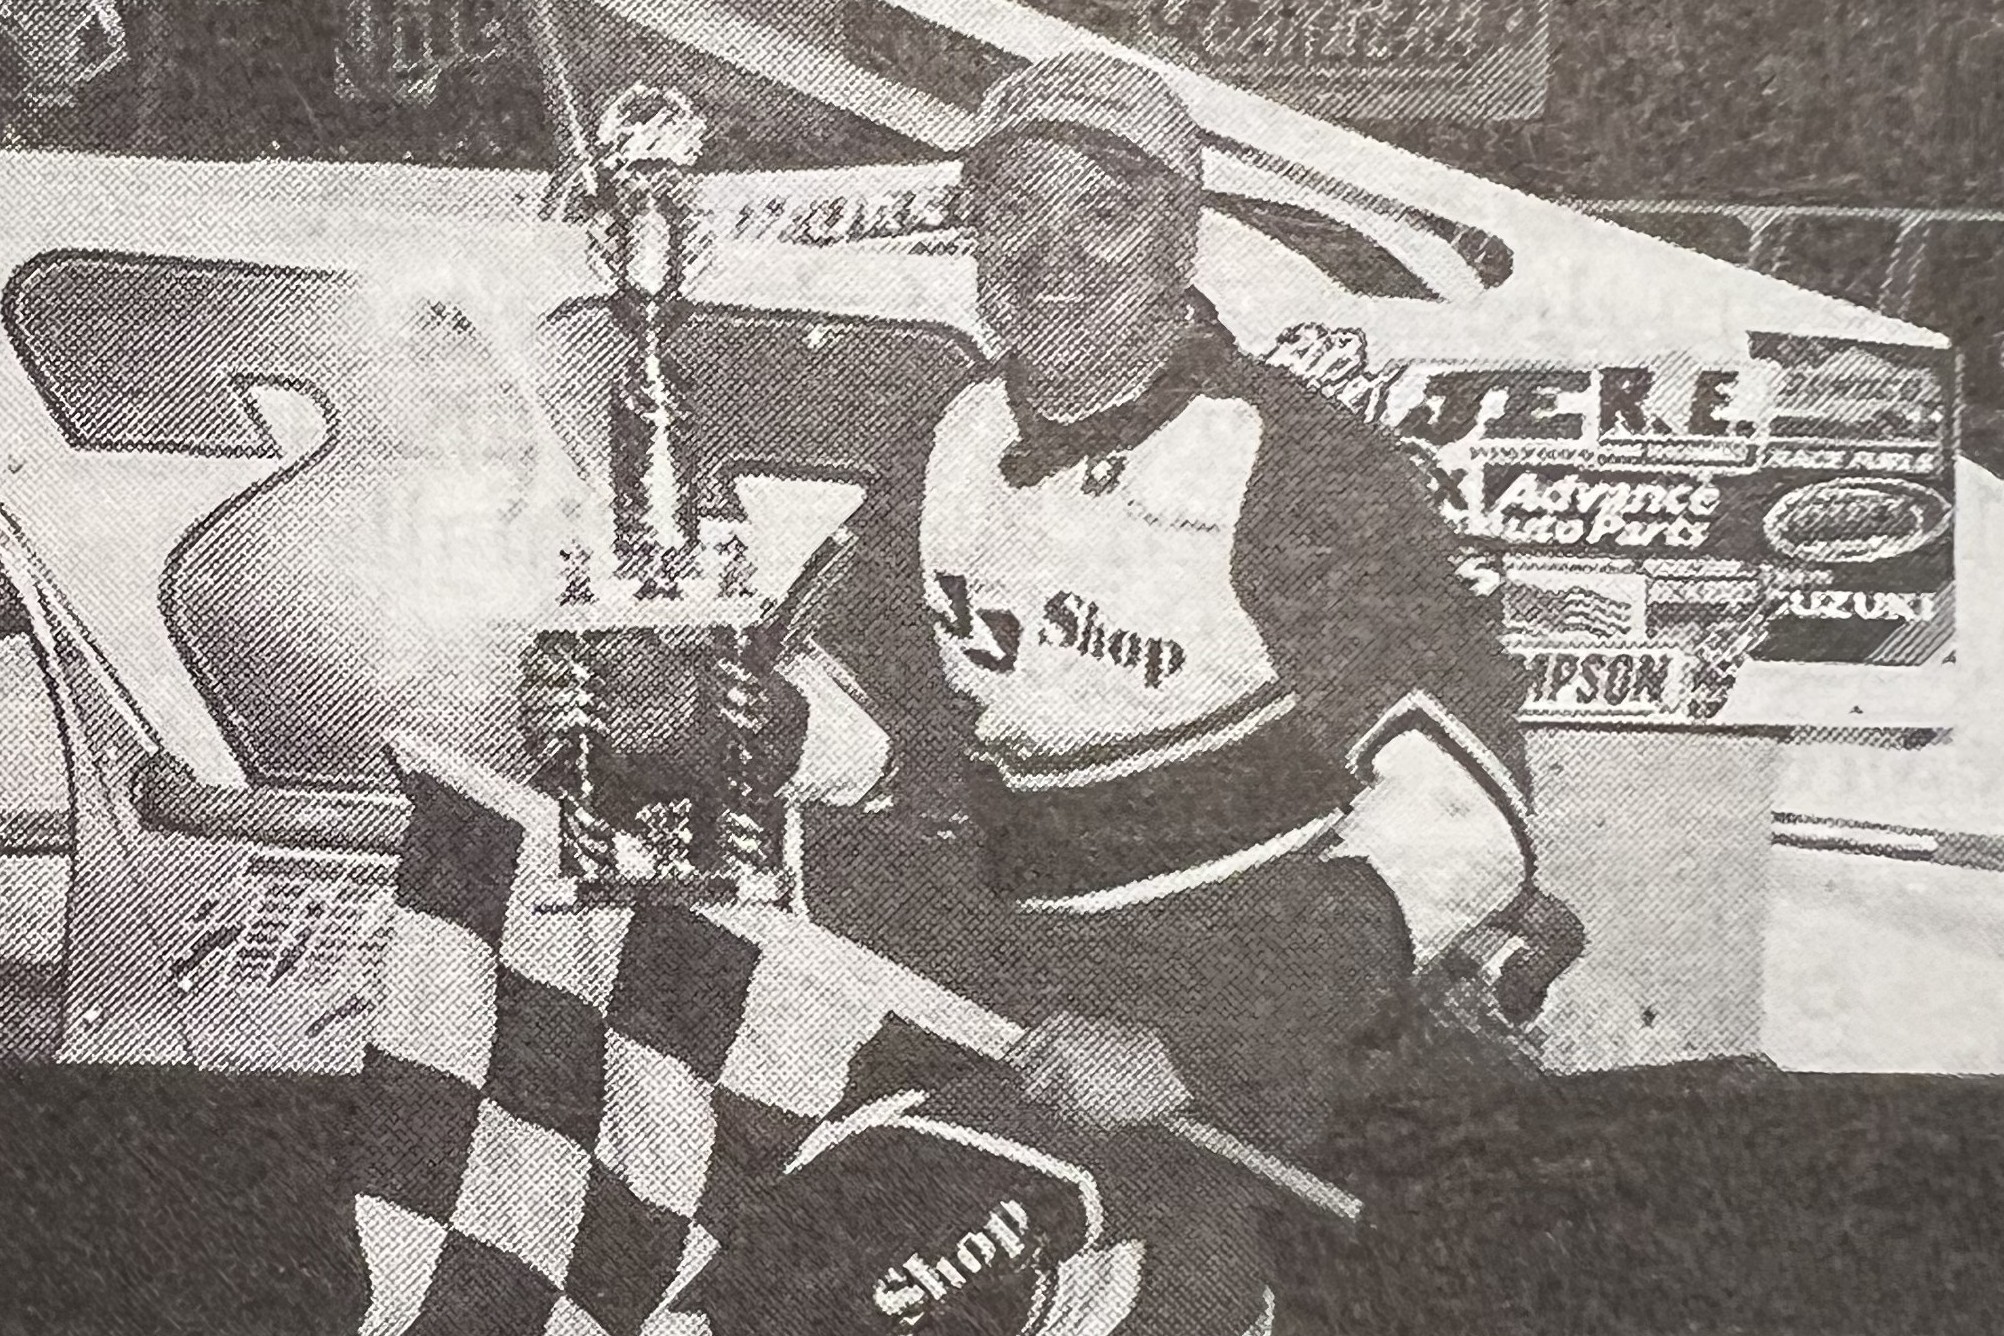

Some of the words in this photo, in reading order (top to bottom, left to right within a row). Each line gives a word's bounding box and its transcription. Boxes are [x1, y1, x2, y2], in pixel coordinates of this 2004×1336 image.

[1495, 472, 1721, 514] Advance
[1586, 513, 1711, 550] Parts
[1038, 589, 1187, 689] Shop
[873, 1200, 1029, 1326] Shop
